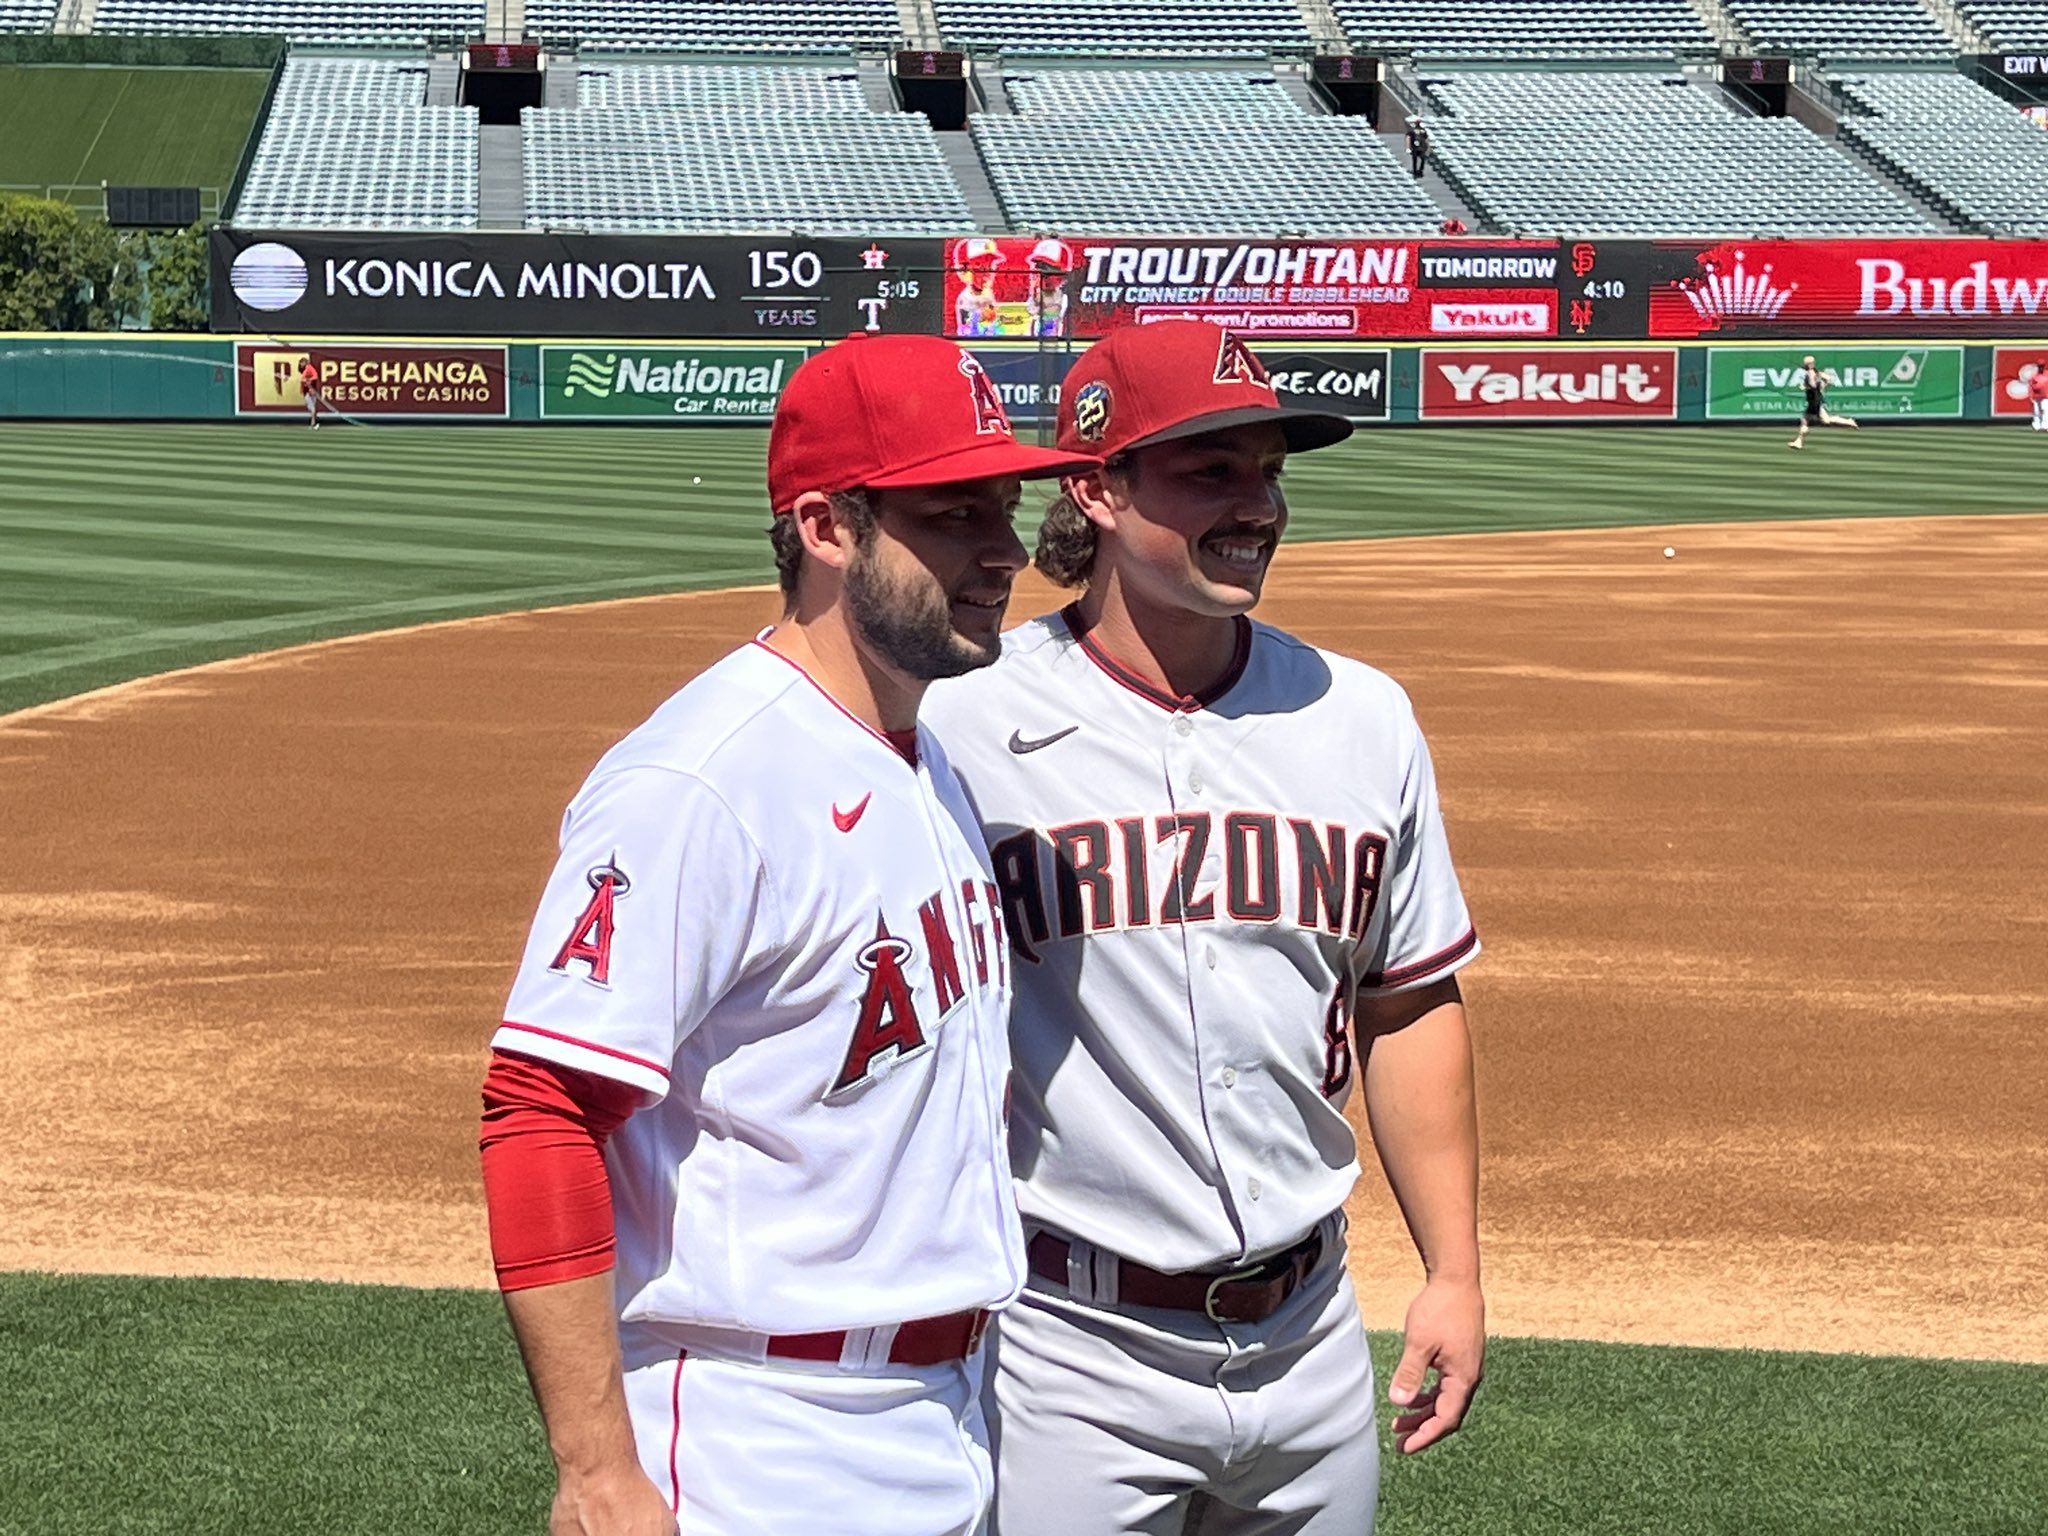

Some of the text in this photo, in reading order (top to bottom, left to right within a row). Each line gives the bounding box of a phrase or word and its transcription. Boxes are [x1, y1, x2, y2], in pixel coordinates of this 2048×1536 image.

[2004, 56, 2037, 73] EXIT
[748, 251, 822, 288] 150
[1084, 245, 1409, 287] TROUT/OHTANI
[1421, 257, 1557, 279] TOMORROW
[325, 259, 716, 300] KONICA MINOLTA
[877, 280, 920, 299] 5:05
[1583, 281, 1625, 299] 4:10
[1080, 286, 1410, 303] CITY CONNECT DOUBLE BOBBLEHEAD
[754, 309, 817, 326] YEARS
[858, 299, 887, 331] T
[1442, 309, 1536, 327] Yakult
[321, 360, 488, 384] PECHANGA
[615, 358, 784, 394] National
[1438, 364, 1661, 402] Yakult
[321, 386, 490, 402] RESORT CASINO
[674, 397, 776, 413] Car Rental
[1077, 389, 1105, 430] 25
[991, 811, 1390, 965] ARIZONA
[549, 850, 631, 989] A
